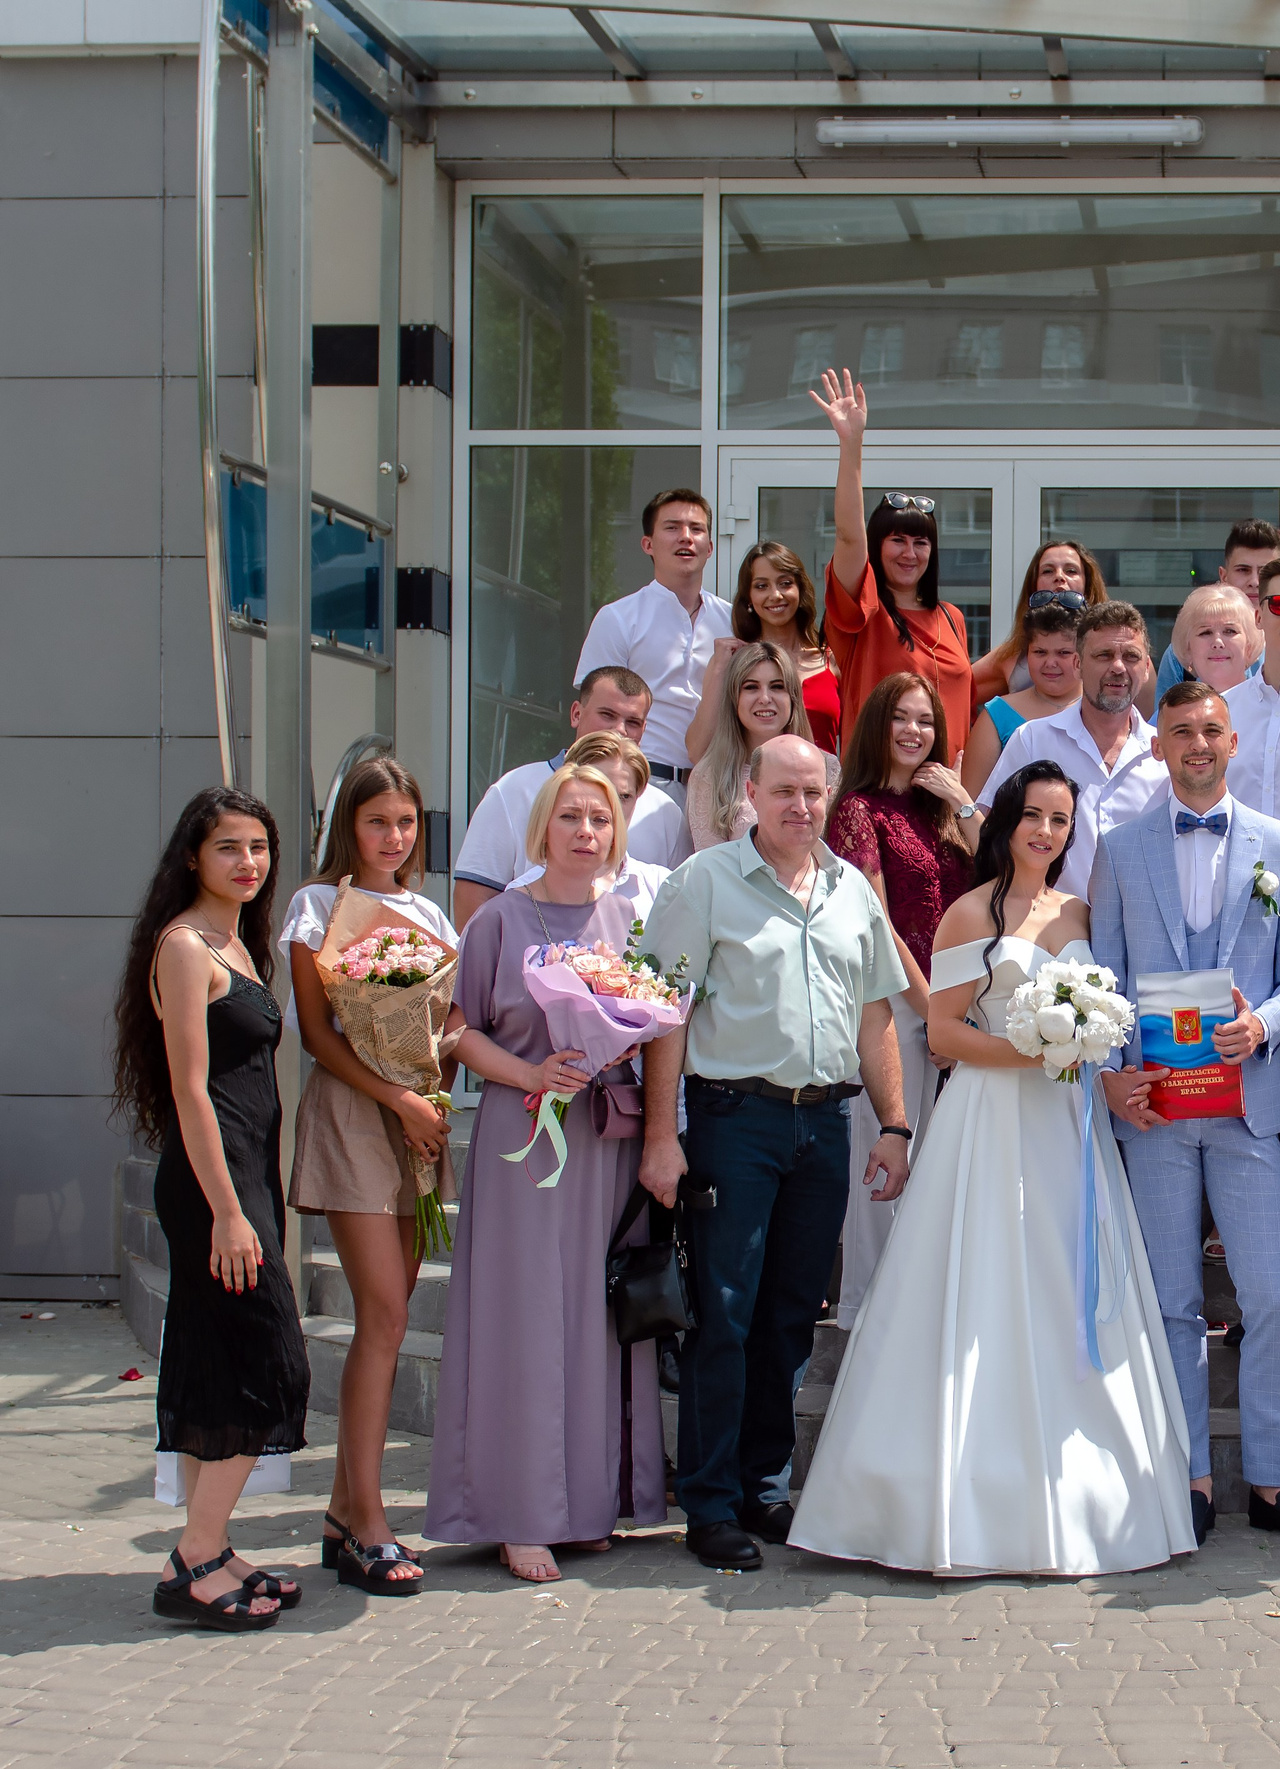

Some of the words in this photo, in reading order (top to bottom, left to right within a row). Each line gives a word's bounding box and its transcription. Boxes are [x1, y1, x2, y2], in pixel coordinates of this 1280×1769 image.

[1169, 1068, 1220, 1078] ИДЕТЕЛЬСТВО
[1168, 1076, 1224, 1087] ЗАКЛЮЧЕНИИ
[1180, 1087, 1207, 1095] БРАКА
